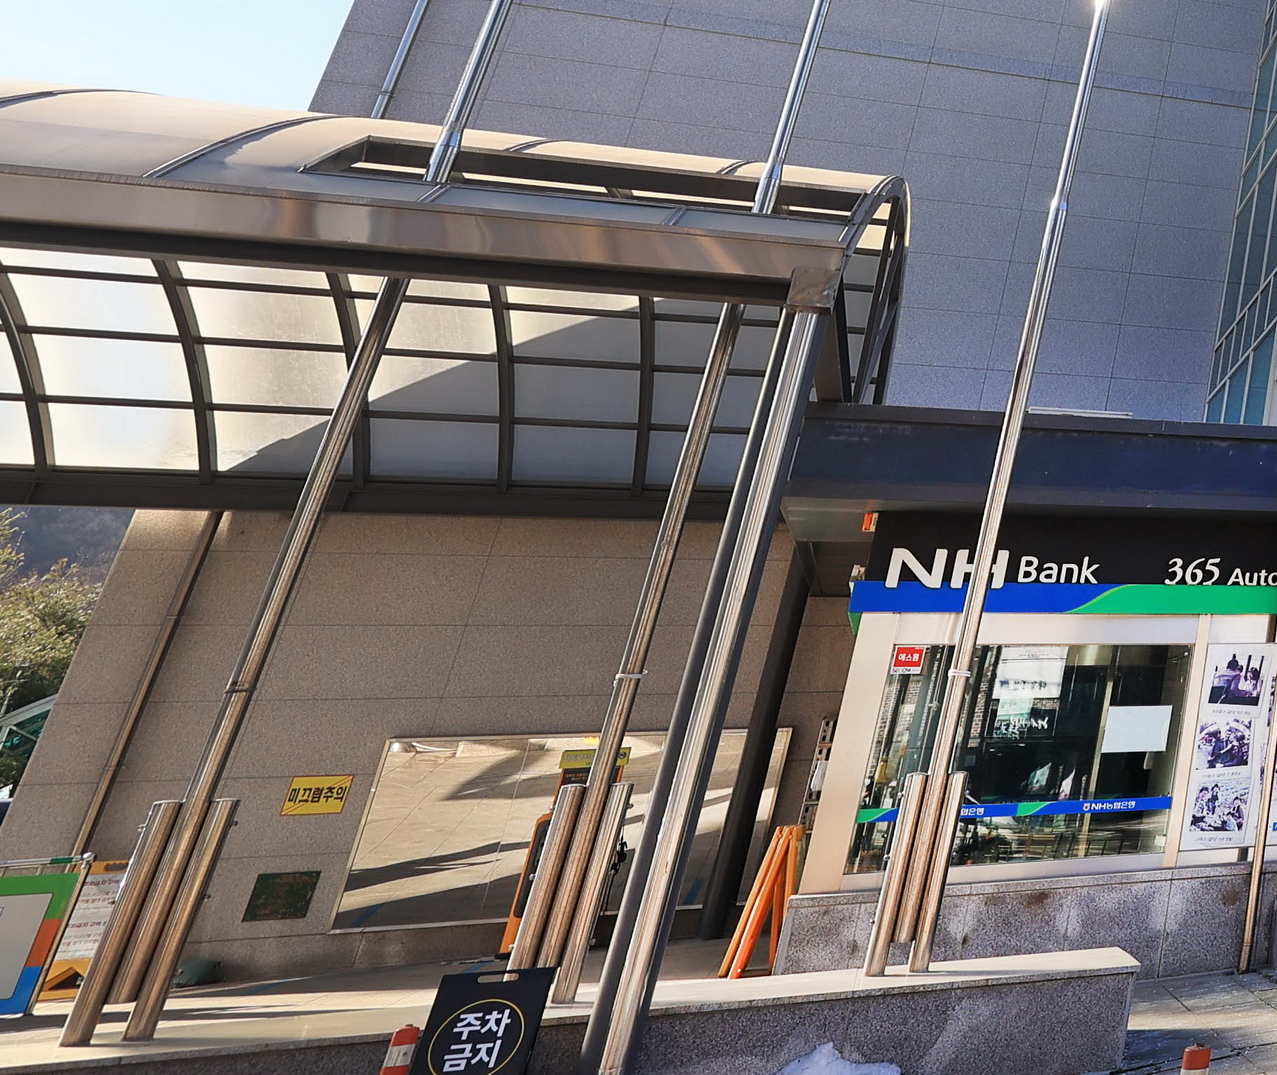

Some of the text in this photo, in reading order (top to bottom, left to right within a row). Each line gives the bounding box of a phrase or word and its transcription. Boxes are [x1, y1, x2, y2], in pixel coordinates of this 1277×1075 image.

[885, 548, 1100, 589] NH Bank
[1164, 557, 1221, 586] 365
[288, 786, 348, 804] 미끄럼주의
[453, 1009, 511, 1040] 주차
[443, 1039, 502, 1073] 금지
